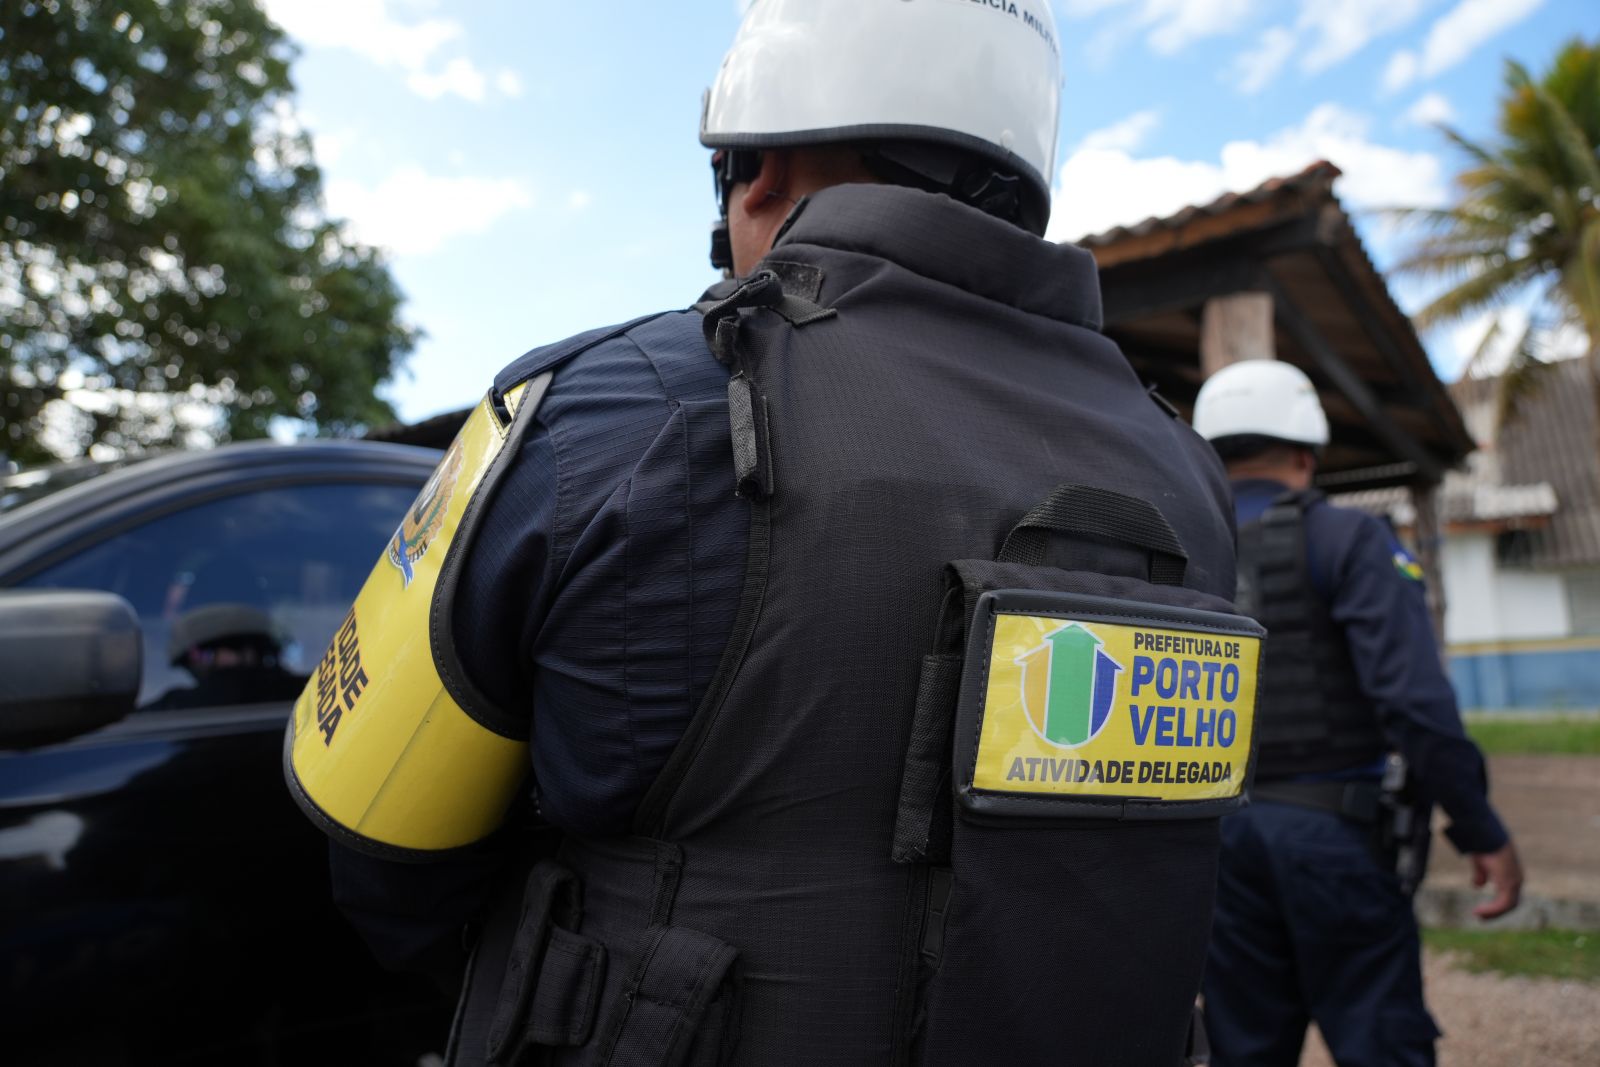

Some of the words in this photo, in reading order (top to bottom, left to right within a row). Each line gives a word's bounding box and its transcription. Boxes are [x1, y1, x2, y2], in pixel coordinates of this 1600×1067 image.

[1134, 632, 1222, 657] PREFEITURA
[1224, 642, 1240, 659] DE
[1131, 655, 1240, 702] PORTO
[1129, 704, 1237, 748] VELHO
[1006, 756, 1135, 784] ATIVIDADE
[1138, 761, 1232, 784] DELEGADA
